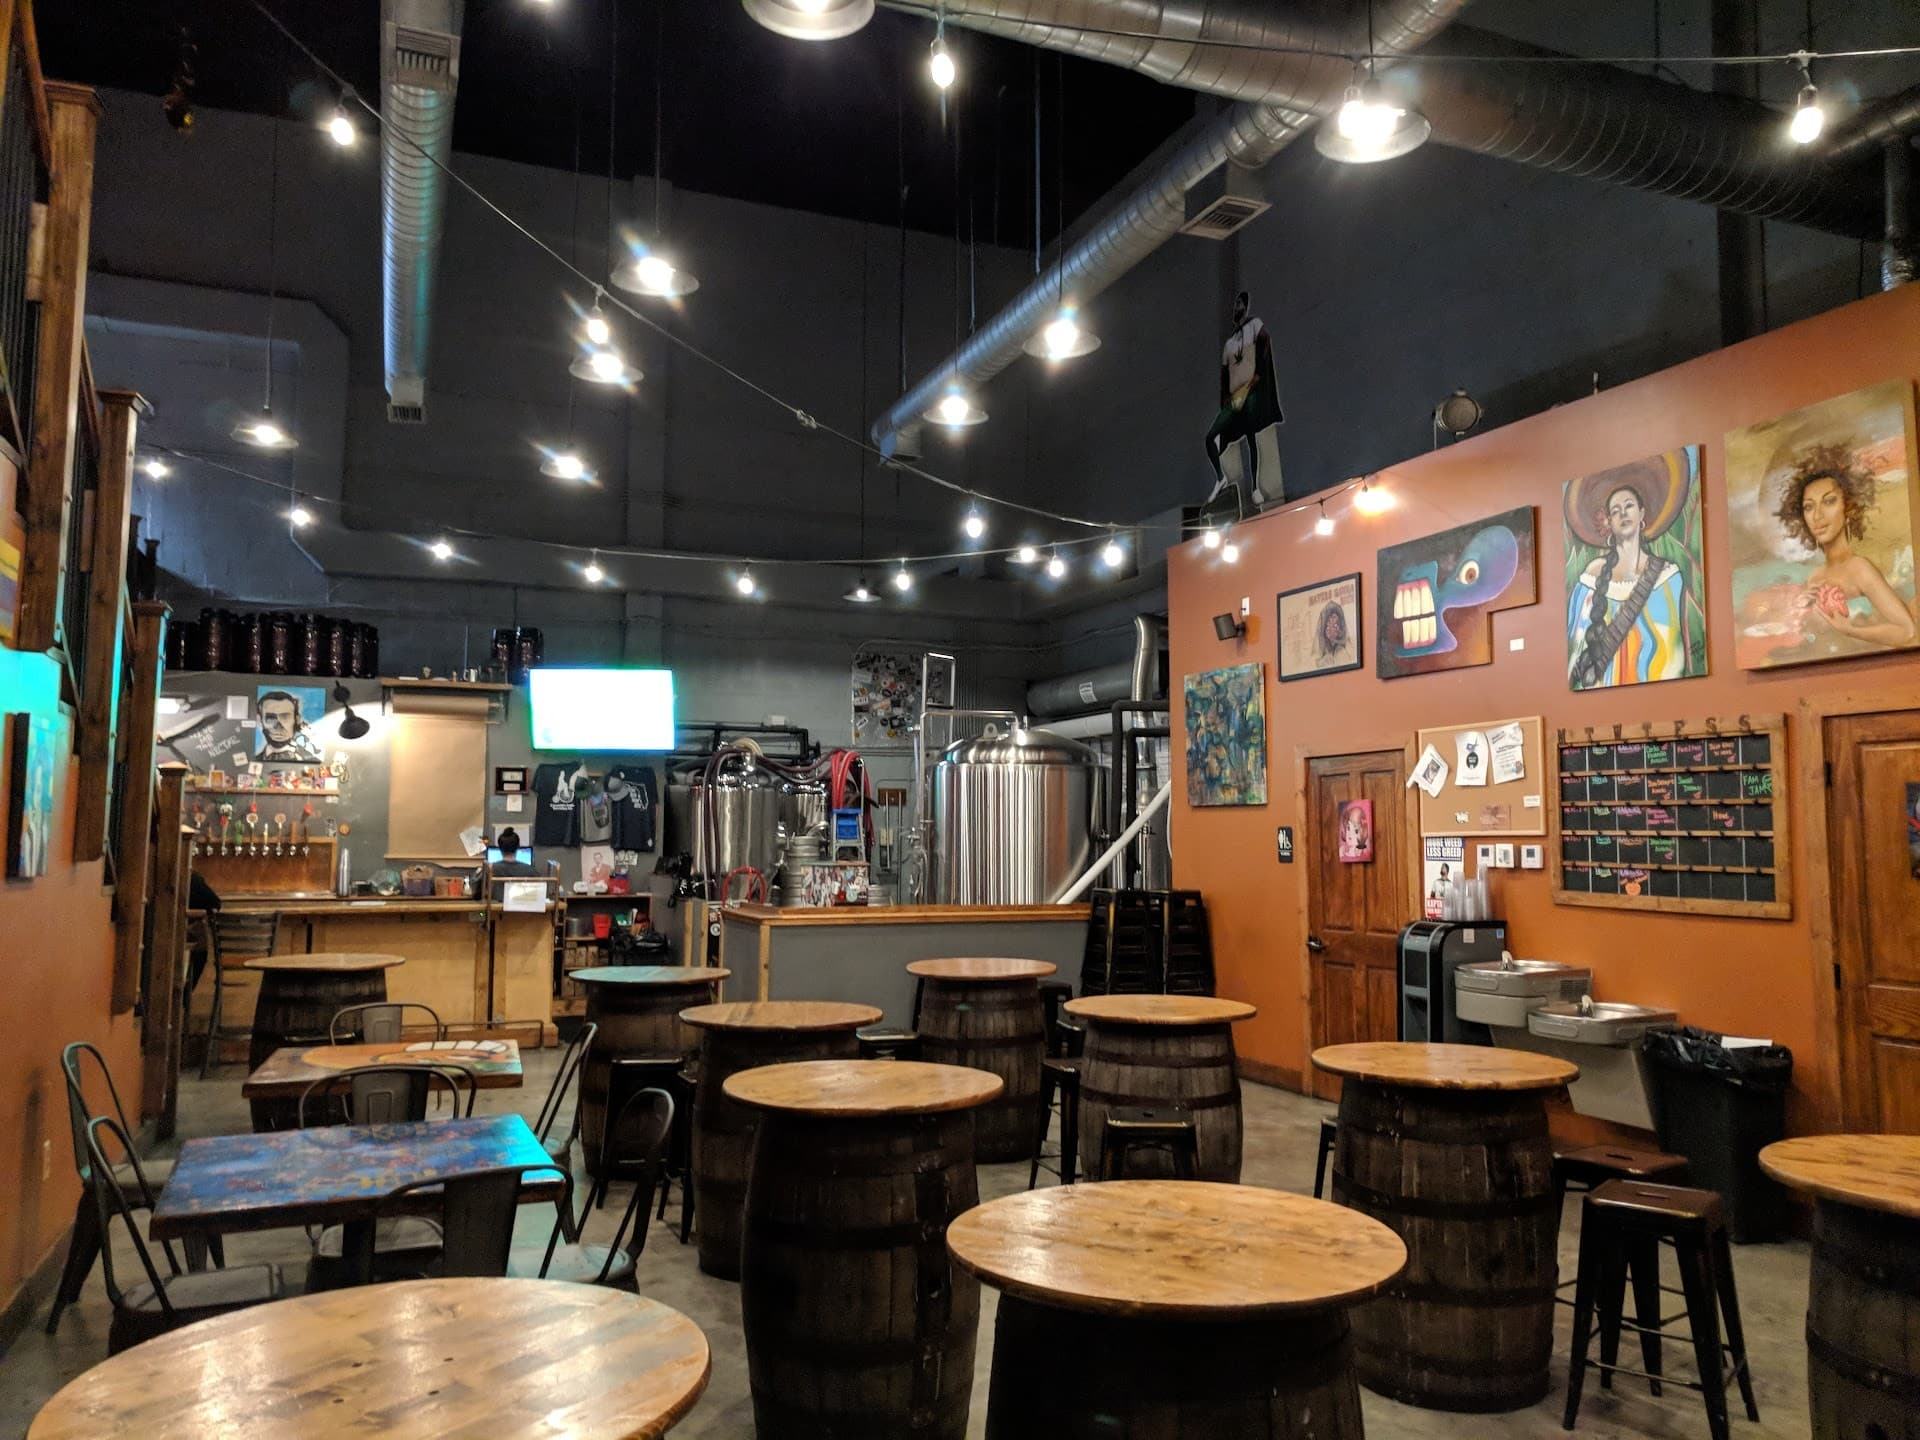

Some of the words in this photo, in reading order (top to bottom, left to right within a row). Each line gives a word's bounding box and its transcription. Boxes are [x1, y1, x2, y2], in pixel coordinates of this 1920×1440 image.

[1584, 726, 1594, 743] T
[1642, 720, 1652, 737] T
[1705, 716, 1719, 734] S
[1738, 714, 1752, 733] S
[1444, 837, 1462, 847] WEED
[1427, 847, 1441, 857] LESS
[1442, 847, 1461, 857] GREED
